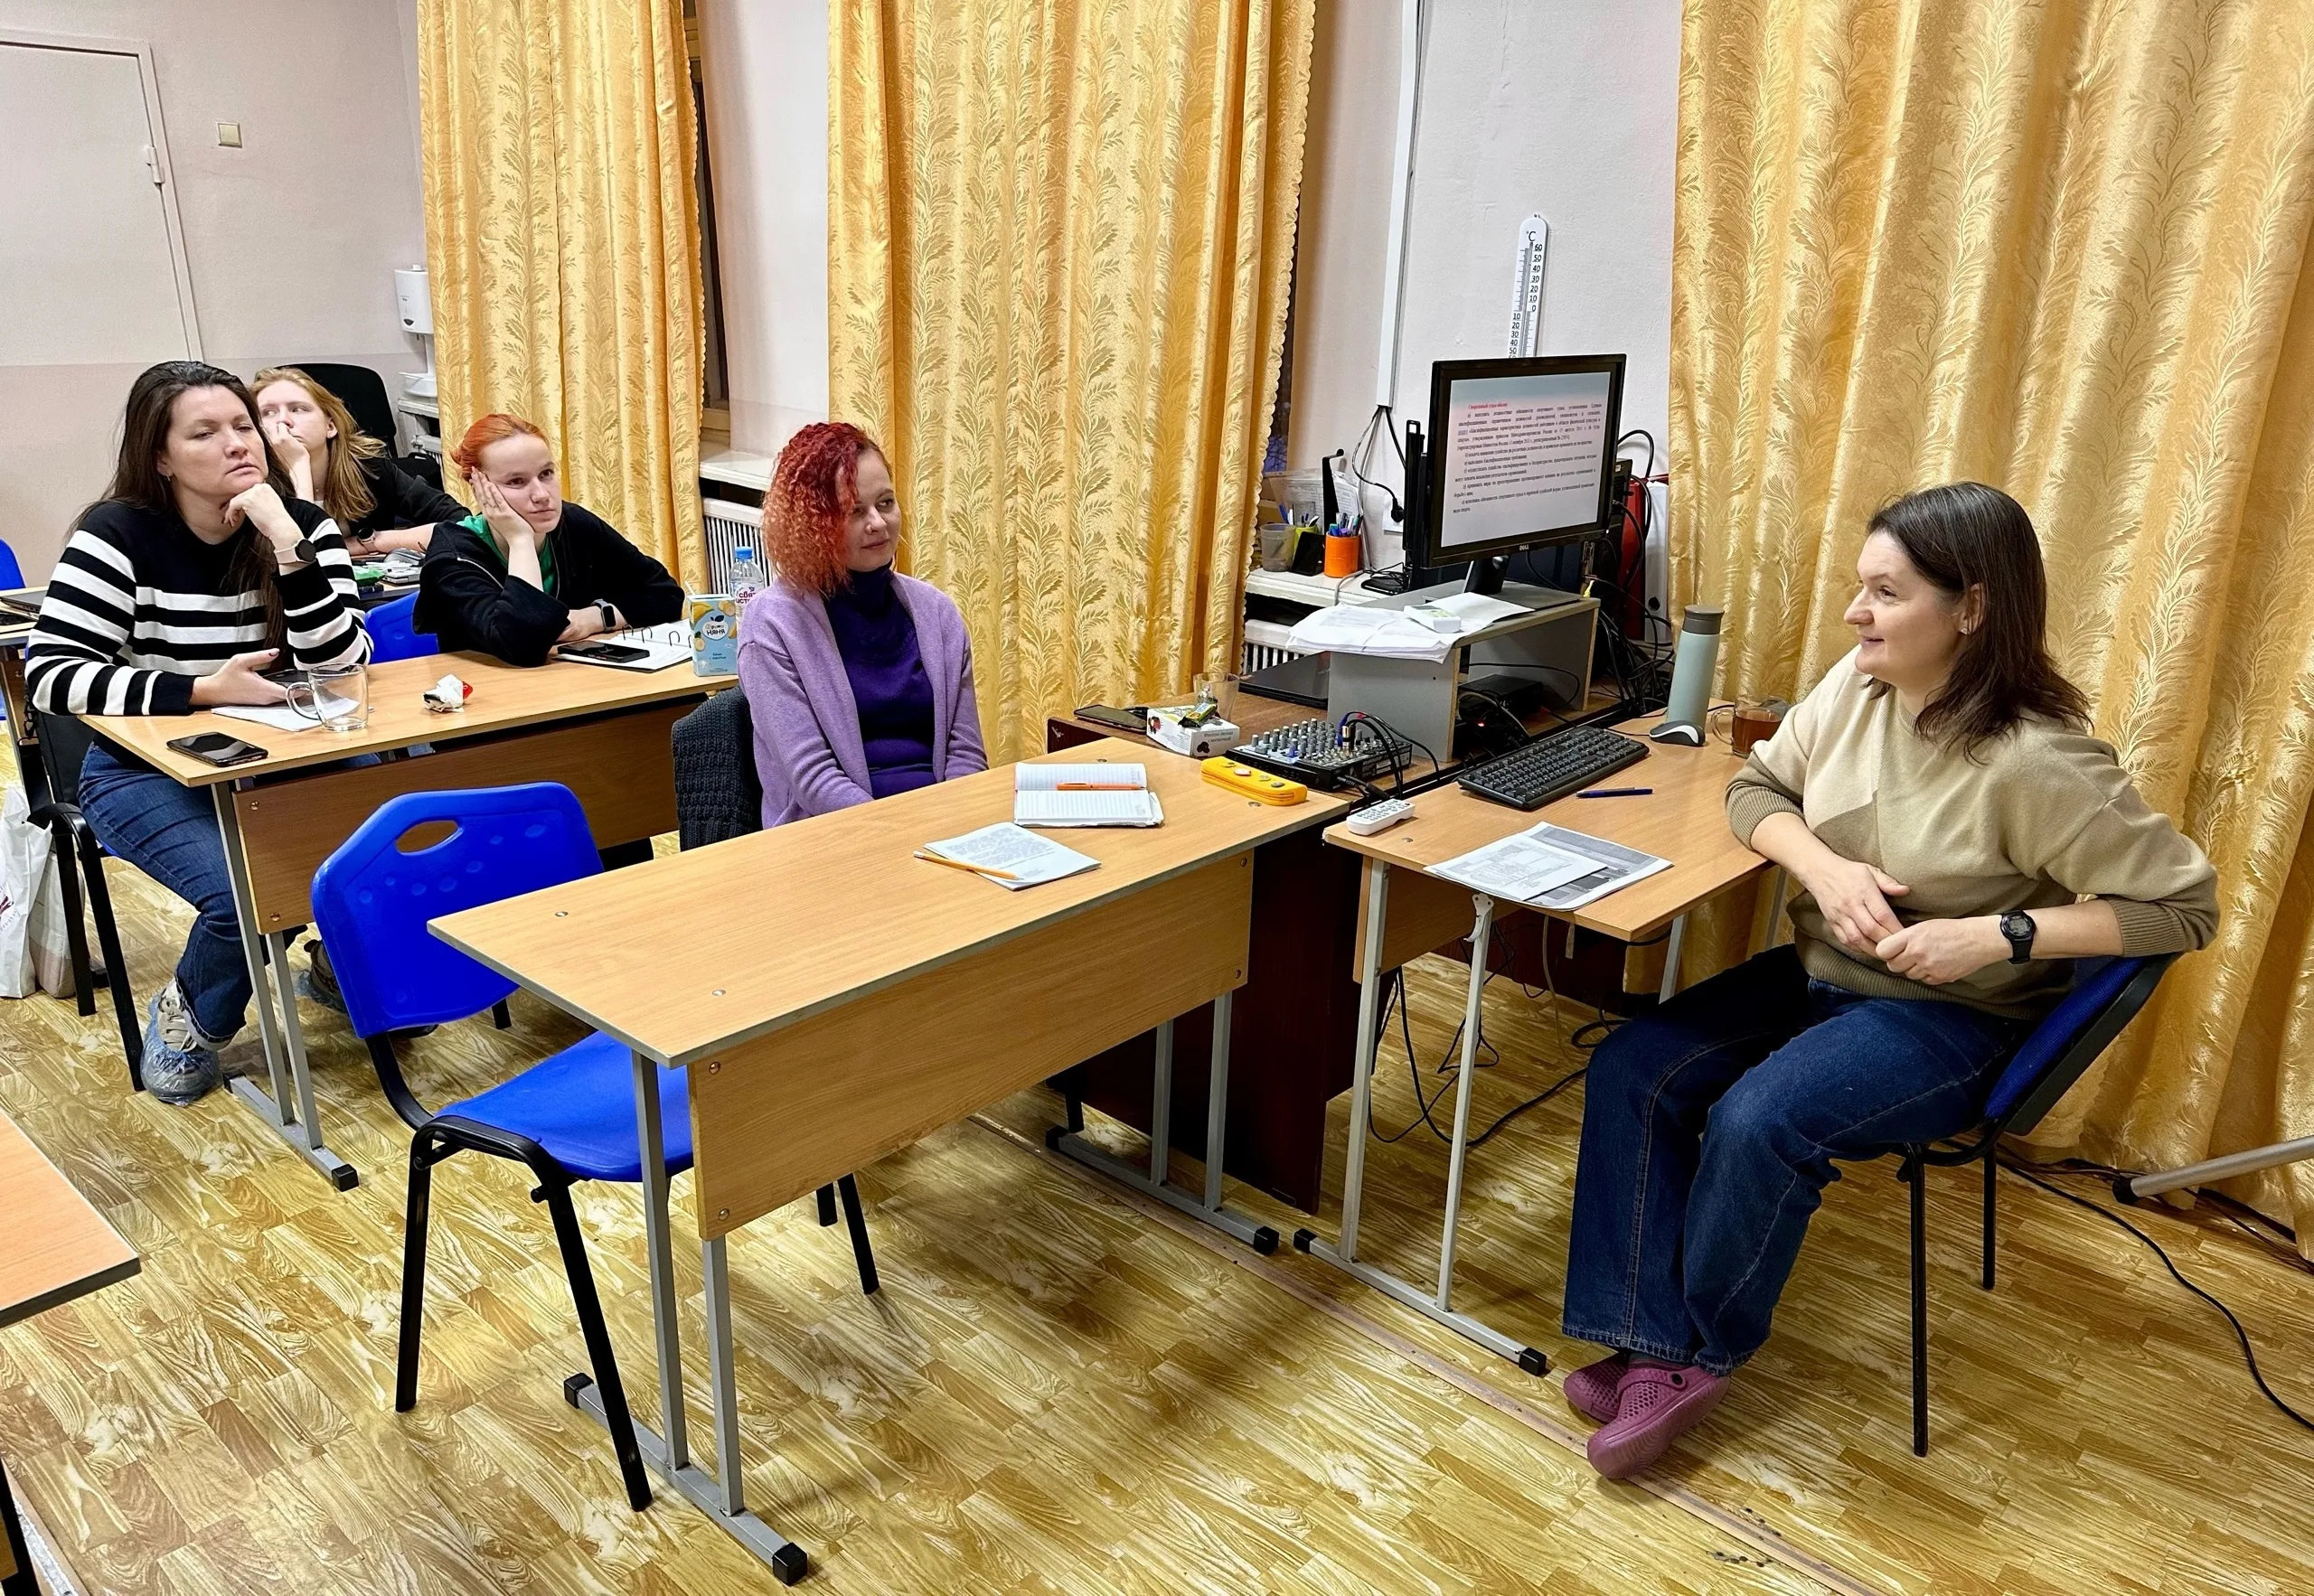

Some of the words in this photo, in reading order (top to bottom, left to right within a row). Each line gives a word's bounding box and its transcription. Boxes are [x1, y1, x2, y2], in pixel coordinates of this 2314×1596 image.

[1533, 254, 1542, 262] 50
[1531, 275, 1540, 283] 30
[1530, 285, 1538, 293] 20
[1510, 330, 1519, 338] 30
